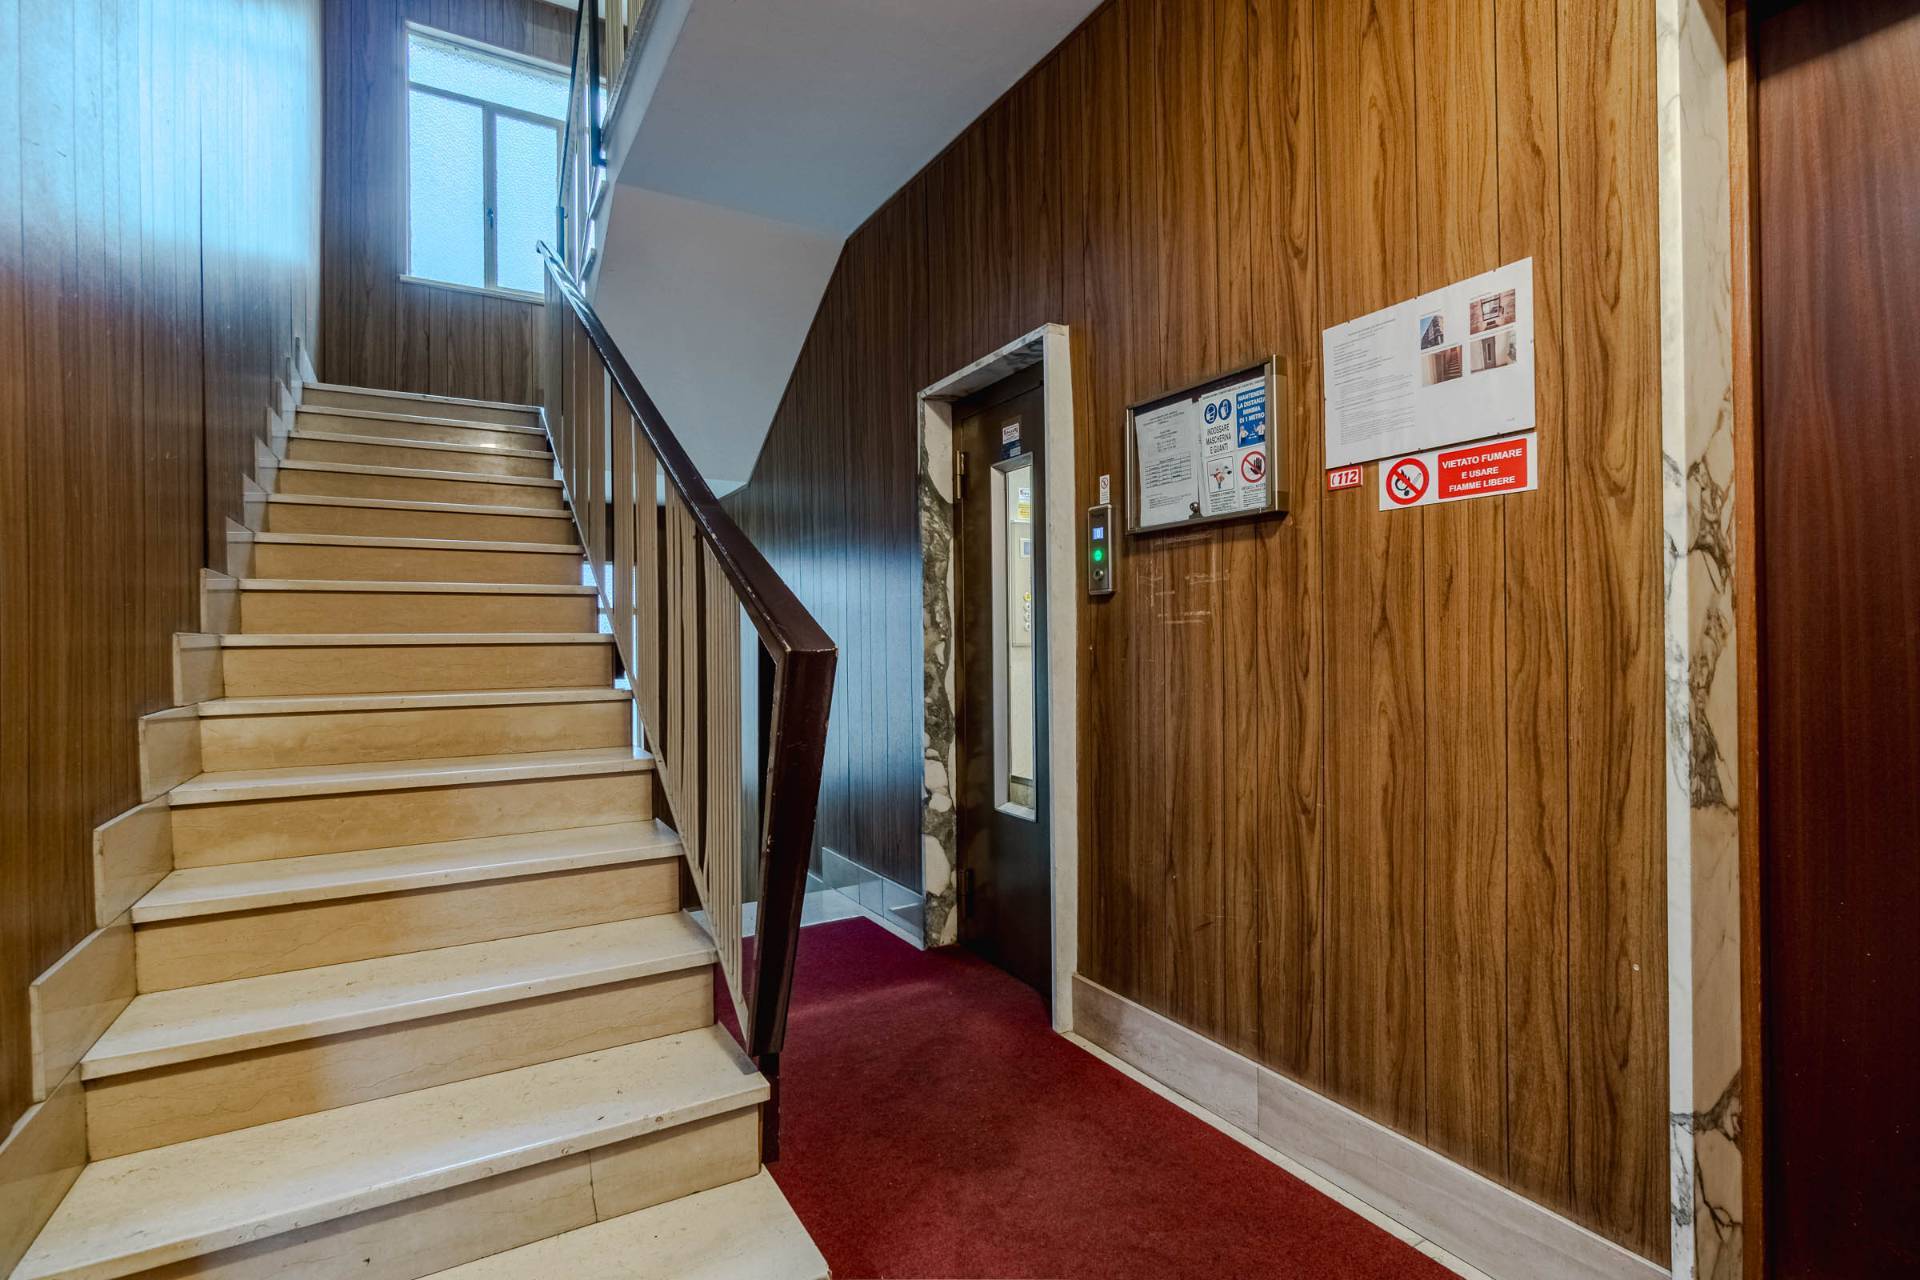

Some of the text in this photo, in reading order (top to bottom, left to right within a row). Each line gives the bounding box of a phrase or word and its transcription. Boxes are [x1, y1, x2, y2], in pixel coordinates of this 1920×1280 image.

[1207, 423, 1230, 436] INDOSSARE
[1205, 432, 1231, 445] MASCHERINA
[1213, 443, 1229, 453] GUANTI
[1442, 448, 1523, 469] VIETATO FUMARE
[1337, 470, 1358, 485] 112
[1461, 466, 1499, 480] E USARE
[1448, 475, 1516, 493] FIAMME LIBERE
